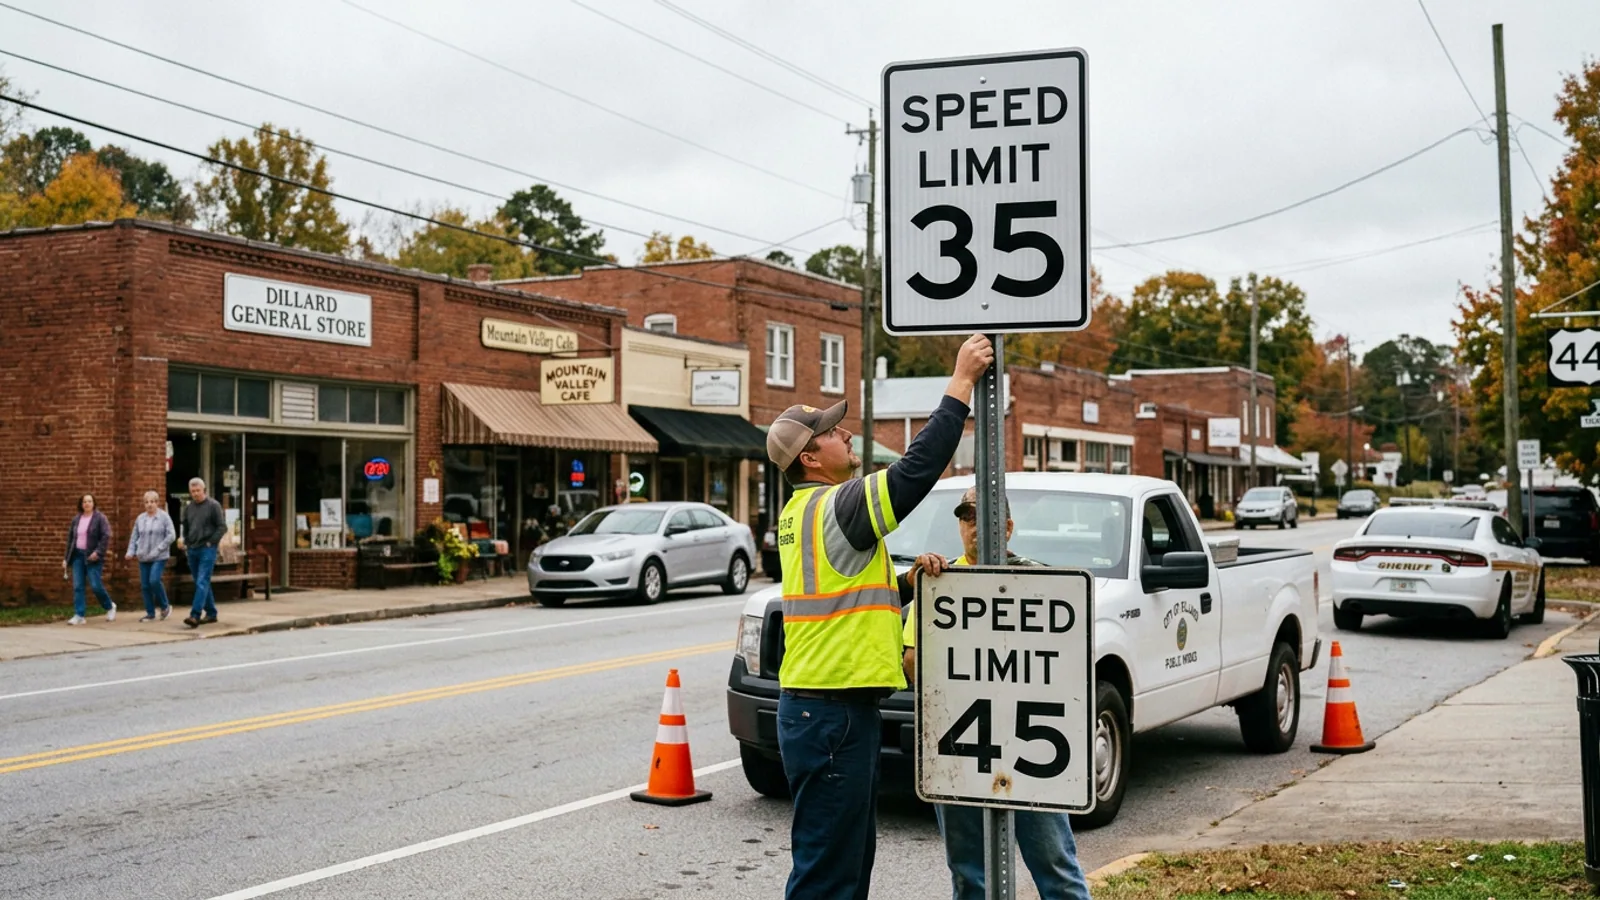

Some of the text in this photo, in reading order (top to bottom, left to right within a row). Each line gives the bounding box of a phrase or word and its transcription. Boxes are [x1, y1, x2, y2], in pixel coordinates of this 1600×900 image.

[901, 86, 1068, 133] SPEED
[919, 143, 1050, 188] LIMIT
[906, 200, 1064, 300] 35
[266, 286, 338, 313] DILLARD
[231, 304, 366, 338] GENERAL STORE
[546, 364, 607, 383] MOUNTAIN
[554, 379, 597, 390] VALLEY
[561, 390, 591, 401] CAFE
[932, 595, 1076, 634] SPEED
[947, 646, 1060, 685] LIMIT
[937, 698, 1071, 779] 45
